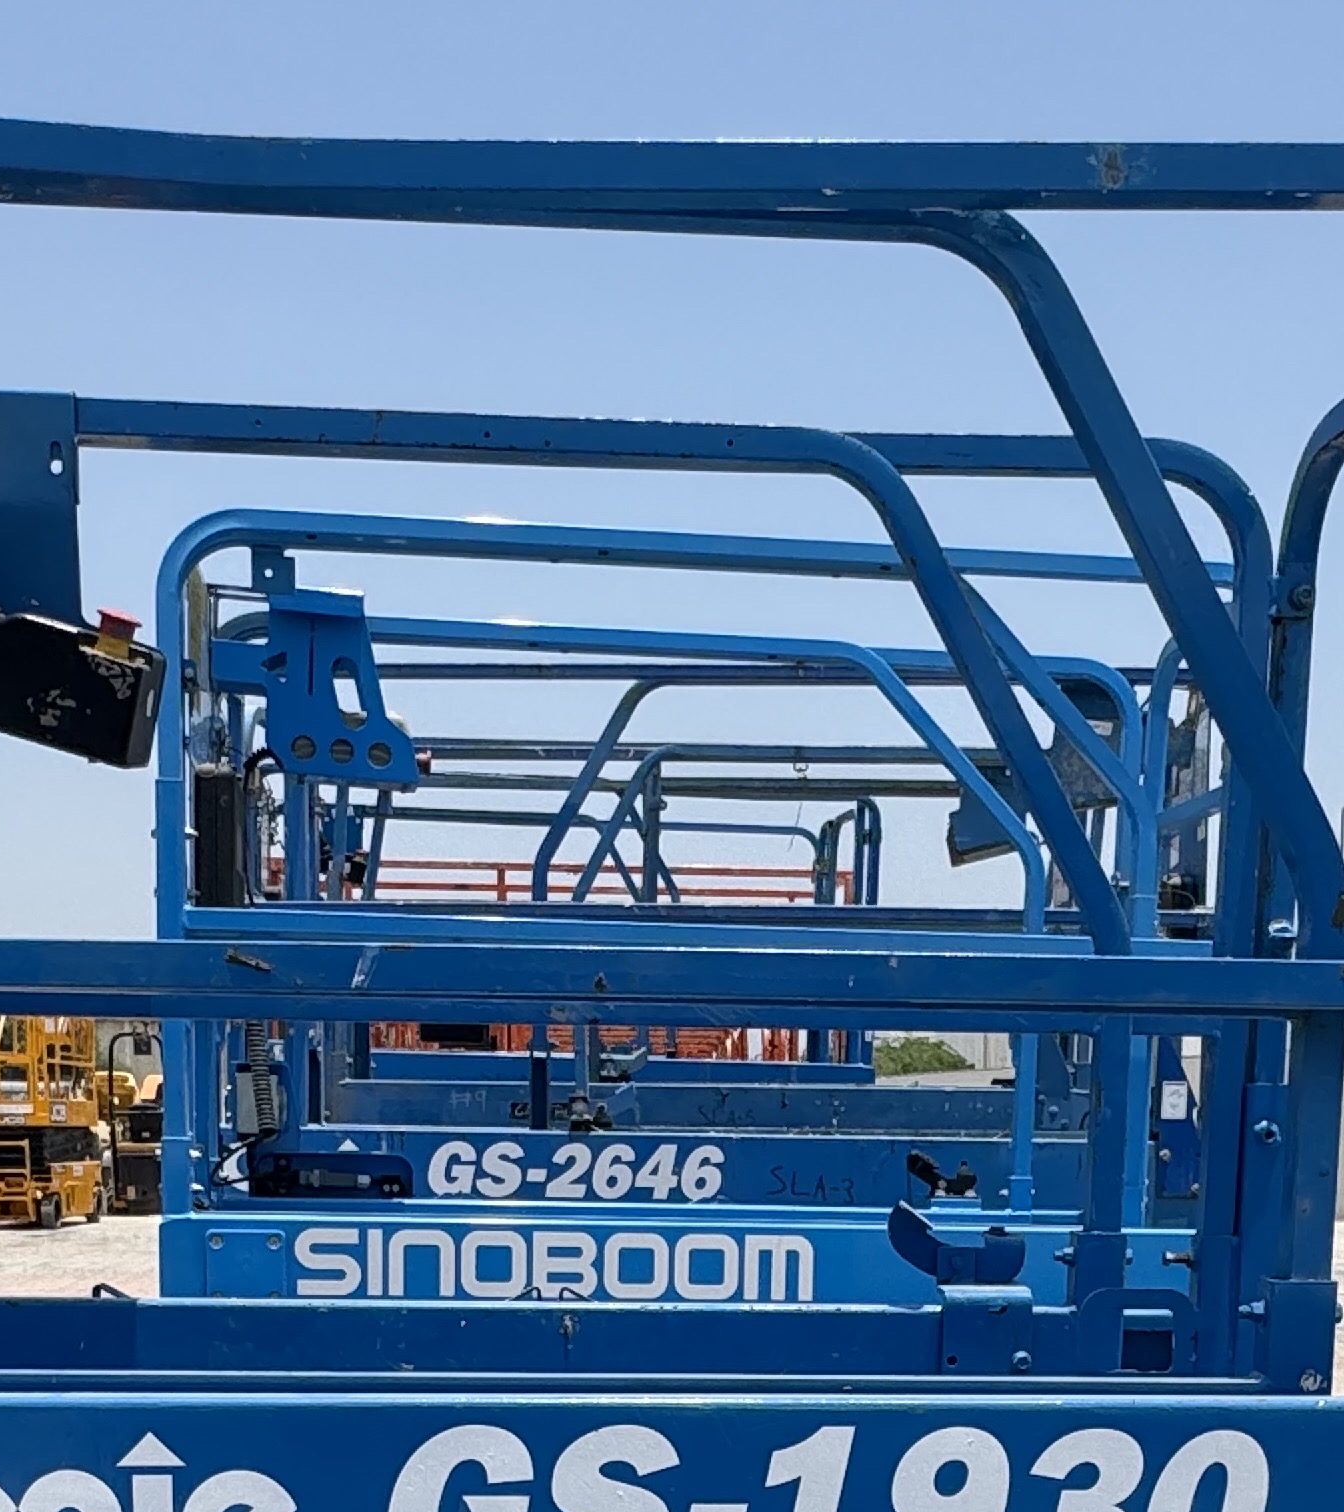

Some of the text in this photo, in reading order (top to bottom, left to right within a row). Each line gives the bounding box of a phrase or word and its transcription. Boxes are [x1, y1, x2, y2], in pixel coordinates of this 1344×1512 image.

[428, 1141, 726, 1201] GS-2646
[766, 1164, 854, 1204] SLA-3
[294, 1229, 815, 1301] SINOBOOM
